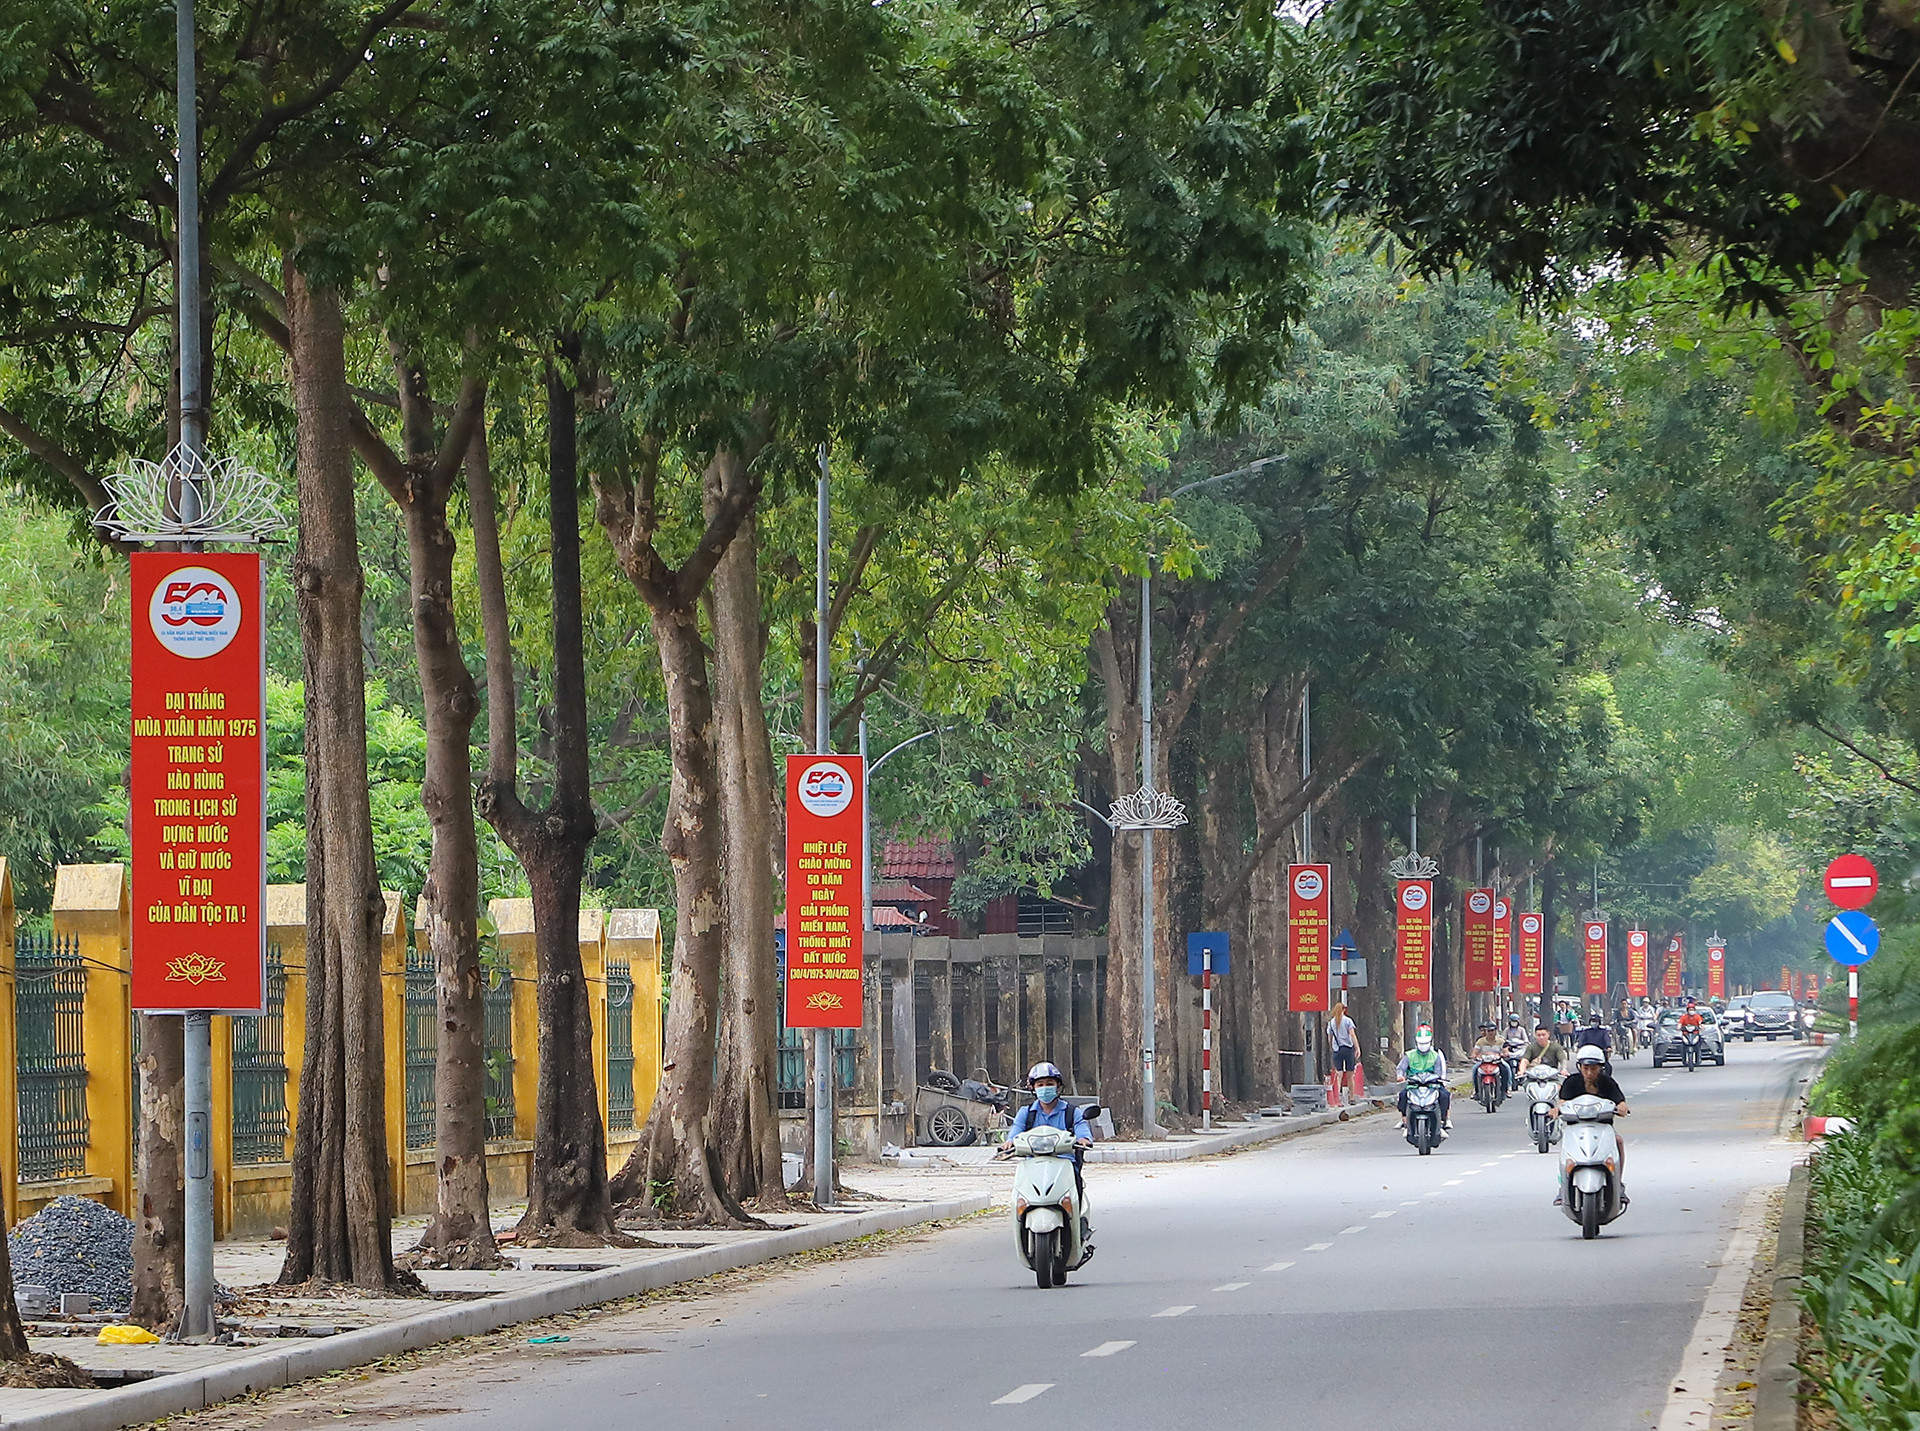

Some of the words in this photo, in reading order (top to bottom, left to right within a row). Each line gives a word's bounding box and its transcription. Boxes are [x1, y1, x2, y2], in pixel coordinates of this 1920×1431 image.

[166, 692, 184, 714] ĐẠI
[188, 687, 225, 710] THẮNG
[134, 716, 161, 736] MÙA
[164, 715, 194, 736] XUÂN
[198, 716, 225, 736] NĂM
[228, 719, 256, 736] 1975
[168, 746, 204, 763] TRANG
[208, 741, 223, 763] SỬ
[168, 769, 190, 790] HÀO
[194, 769, 224, 790] HÙNG
[154, 799, 190, 816] TRONG
[194, 799, 218, 820] LỊCH
[222, 794, 238, 816] SỬ
[163, 825, 194, 846] DỰNG
[198, 822, 228, 843] NƯỚC
[803, 841, 827, 855] NHIỆT
[830, 841, 847, 855] LIỆT
[160, 849, 174, 869] VÀ
[178, 849, 197, 869] GIỮ
[200, 848, 231, 869] NƯỚC
[799, 856, 822, 869] CHÀO
[824, 857, 851, 869] MỪNG
[179, 875, 190, 896] VĨ
[193, 879, 212, 899] ĐẠI
[807, 875, 819, 885] 50
[822, 872, 842, 885] NĂM
[812, 888, 835, 900] NGÀY
[148, 900, 171, 922] CỦA
[174, 901, 197, 922] DÂN
[200, 902, 222, 926] TỘC
[225, 906, 238, 922] TA
[242, 906, 246, 922] !
[801, 902, 817, 916] GIẢI
[820, 904, 849, 916] PHÓNG
[825, 922, 850, 933] NAM,
[798, 935, 826, 947] THỐNG
[829, 935, 851, 947] NHẤT
[803, 951, 820, 963] ĐẤT
[822, 951, 846, 963] NƯỚC
[790, 968, 859, 980] (30/4/1975-30/4/2025)
